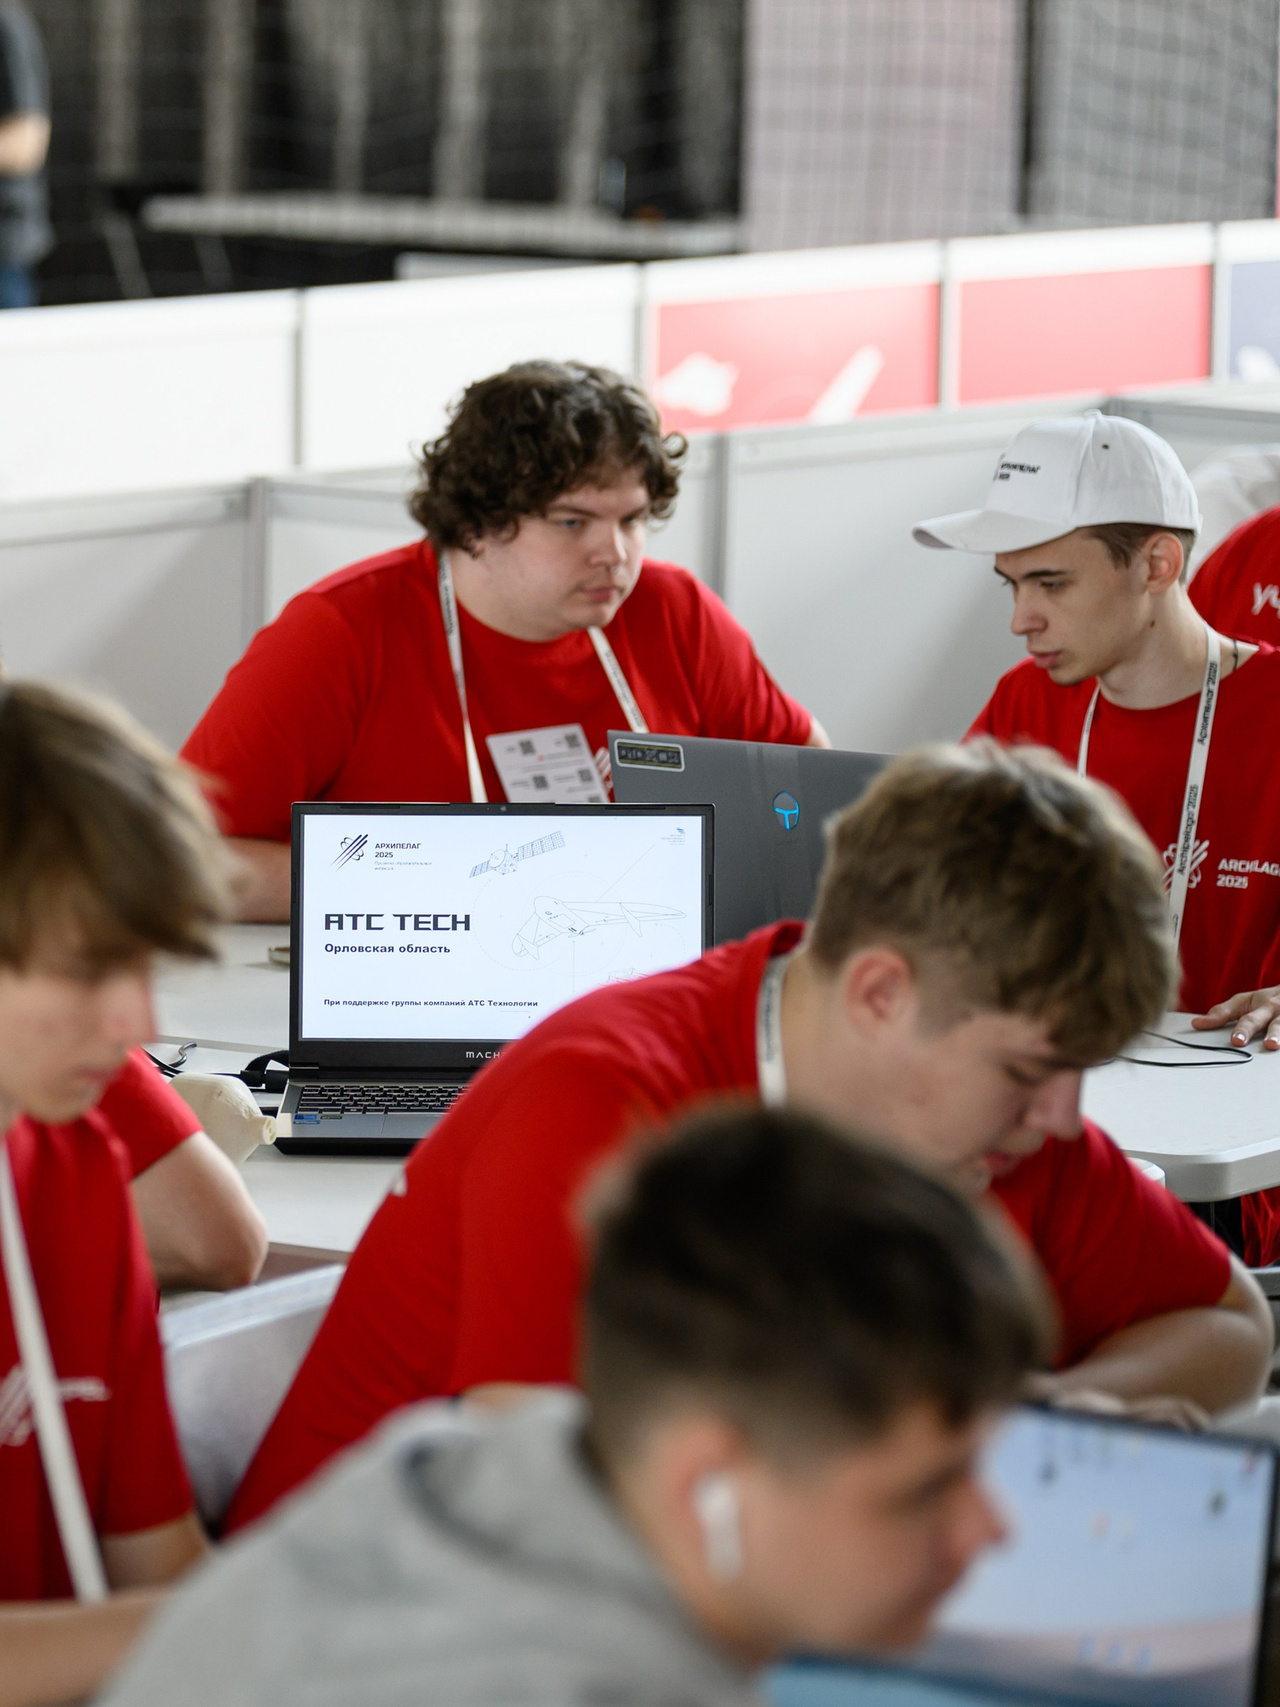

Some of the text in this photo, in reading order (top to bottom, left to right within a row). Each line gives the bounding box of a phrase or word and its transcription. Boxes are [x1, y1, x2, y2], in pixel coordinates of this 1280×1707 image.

[374, 842, 422, 850] АРХИПЕЛАГ
[392, 913, 471, 931] TECH
[324, 943, 451, 954] Орловская область
[323, 999, 341, 1007] При
[391, 1000, 422, 1008] группы
[423, 999, 466, 1007] компаний
[487, 999, 539, 1007] Технологии
